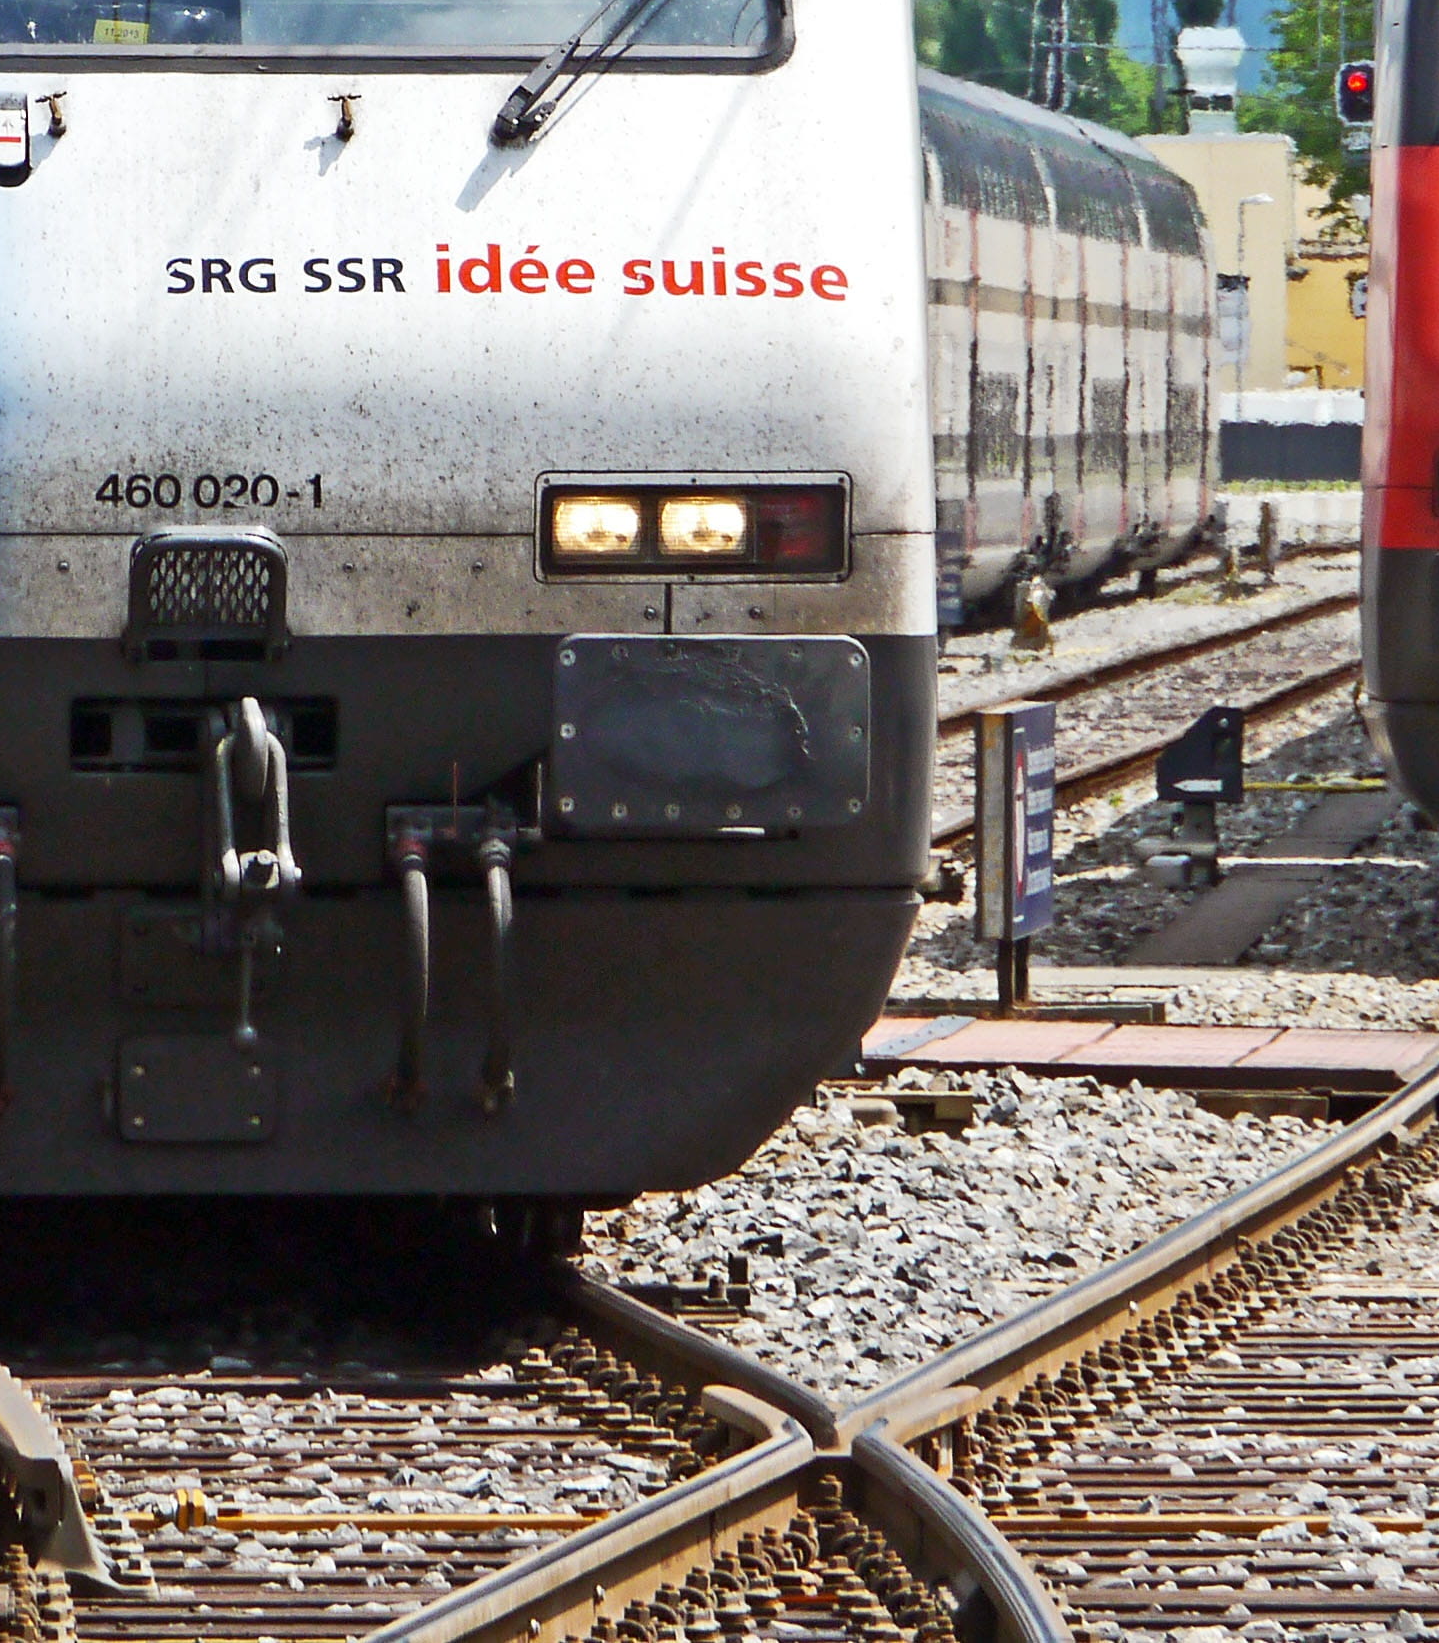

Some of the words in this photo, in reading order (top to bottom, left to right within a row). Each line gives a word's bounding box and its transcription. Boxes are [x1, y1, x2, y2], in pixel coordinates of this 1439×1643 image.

[165, 257, 277, 294] SRG
[303, 257, 407, 293] SSR
[435, 243, 596, 294] idée
[621, 246, 850, 302] suisse
[95, 472, 182, 509] 460
